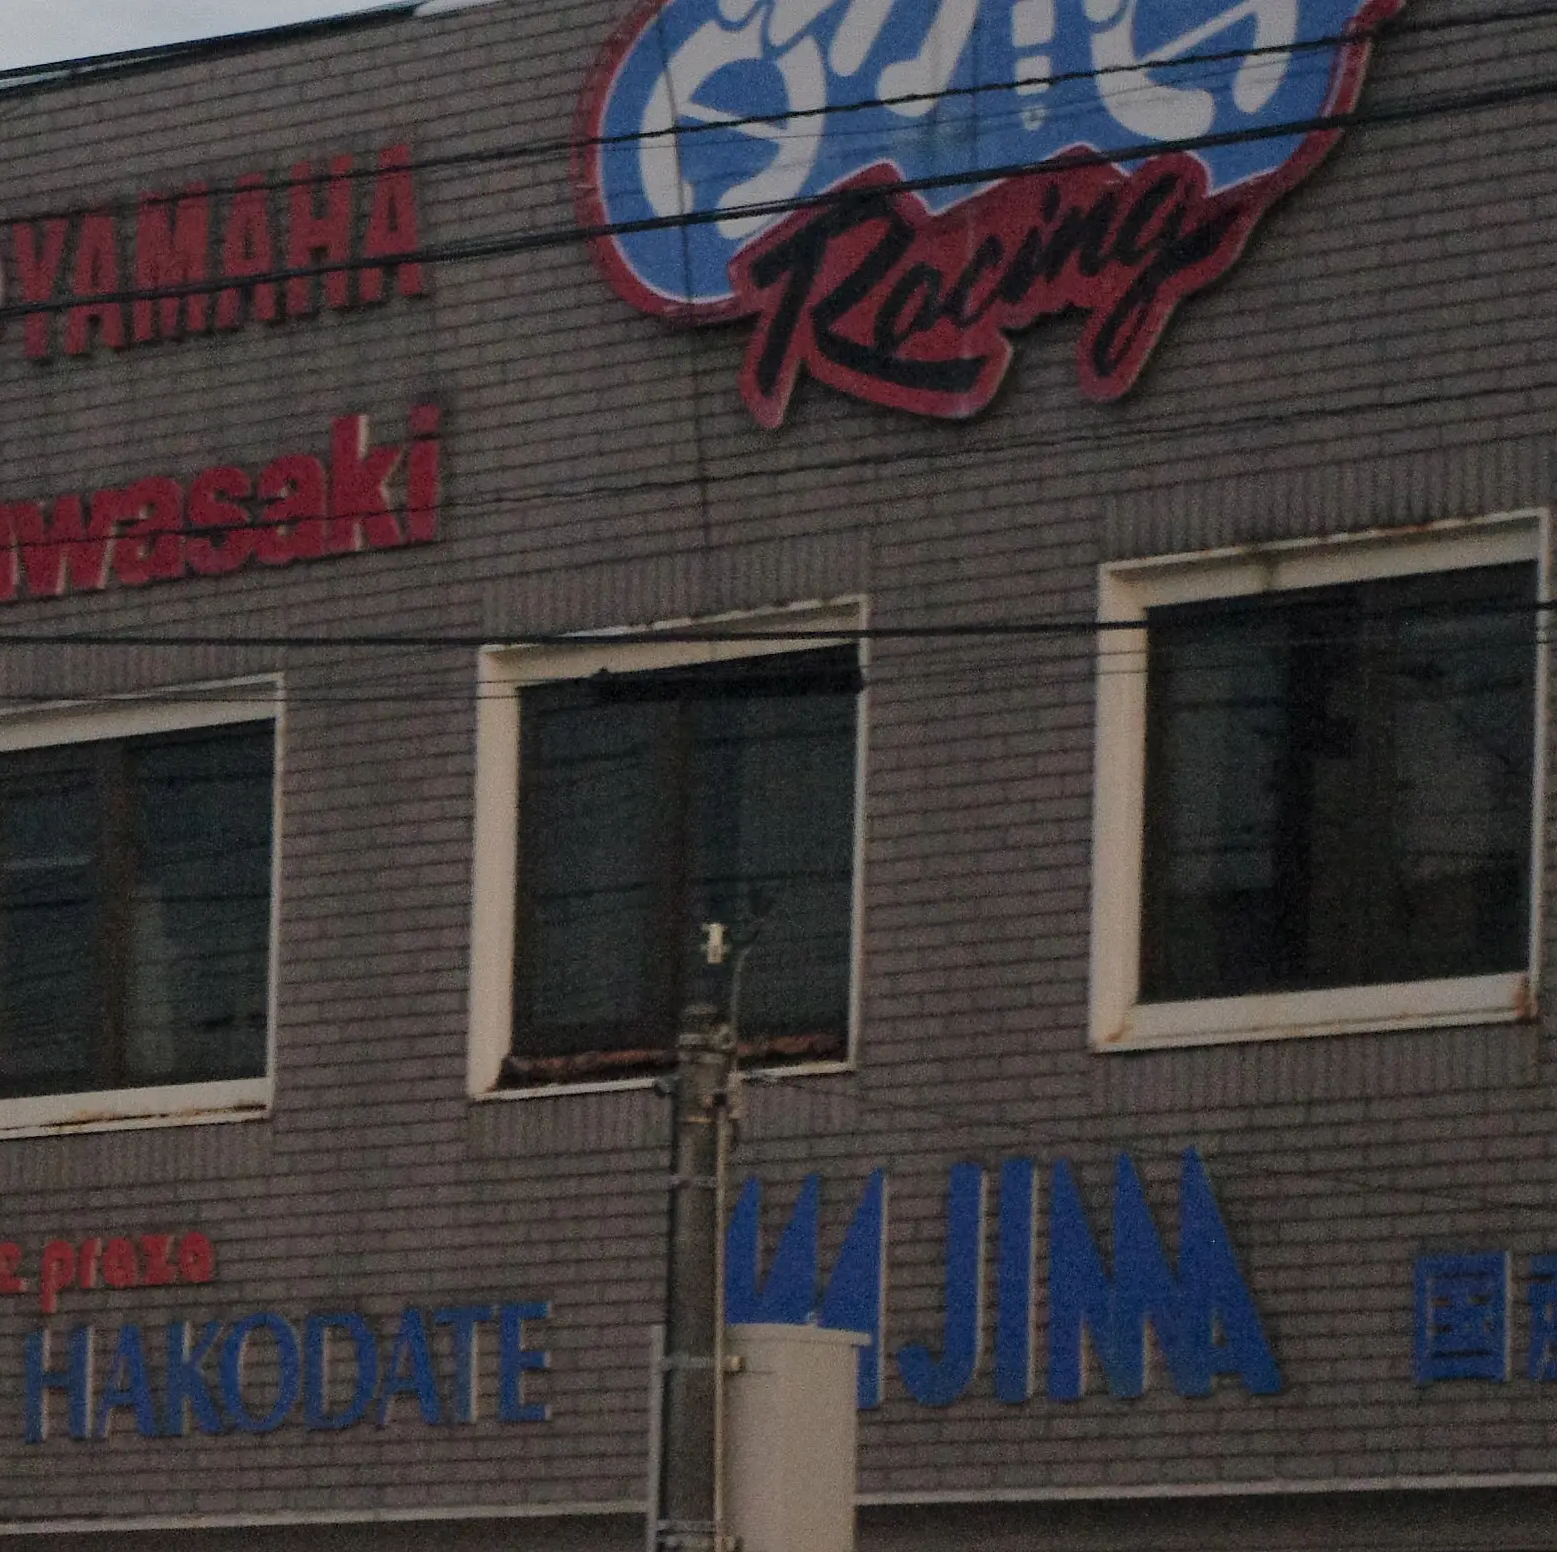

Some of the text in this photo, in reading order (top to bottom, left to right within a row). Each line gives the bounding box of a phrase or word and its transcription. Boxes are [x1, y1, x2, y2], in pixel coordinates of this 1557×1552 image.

[12, 143, 425, 359] YAMAHA
[751, 176, 1241, 396] Racing
[24, 1300, 553, 1445] HAKODATE
